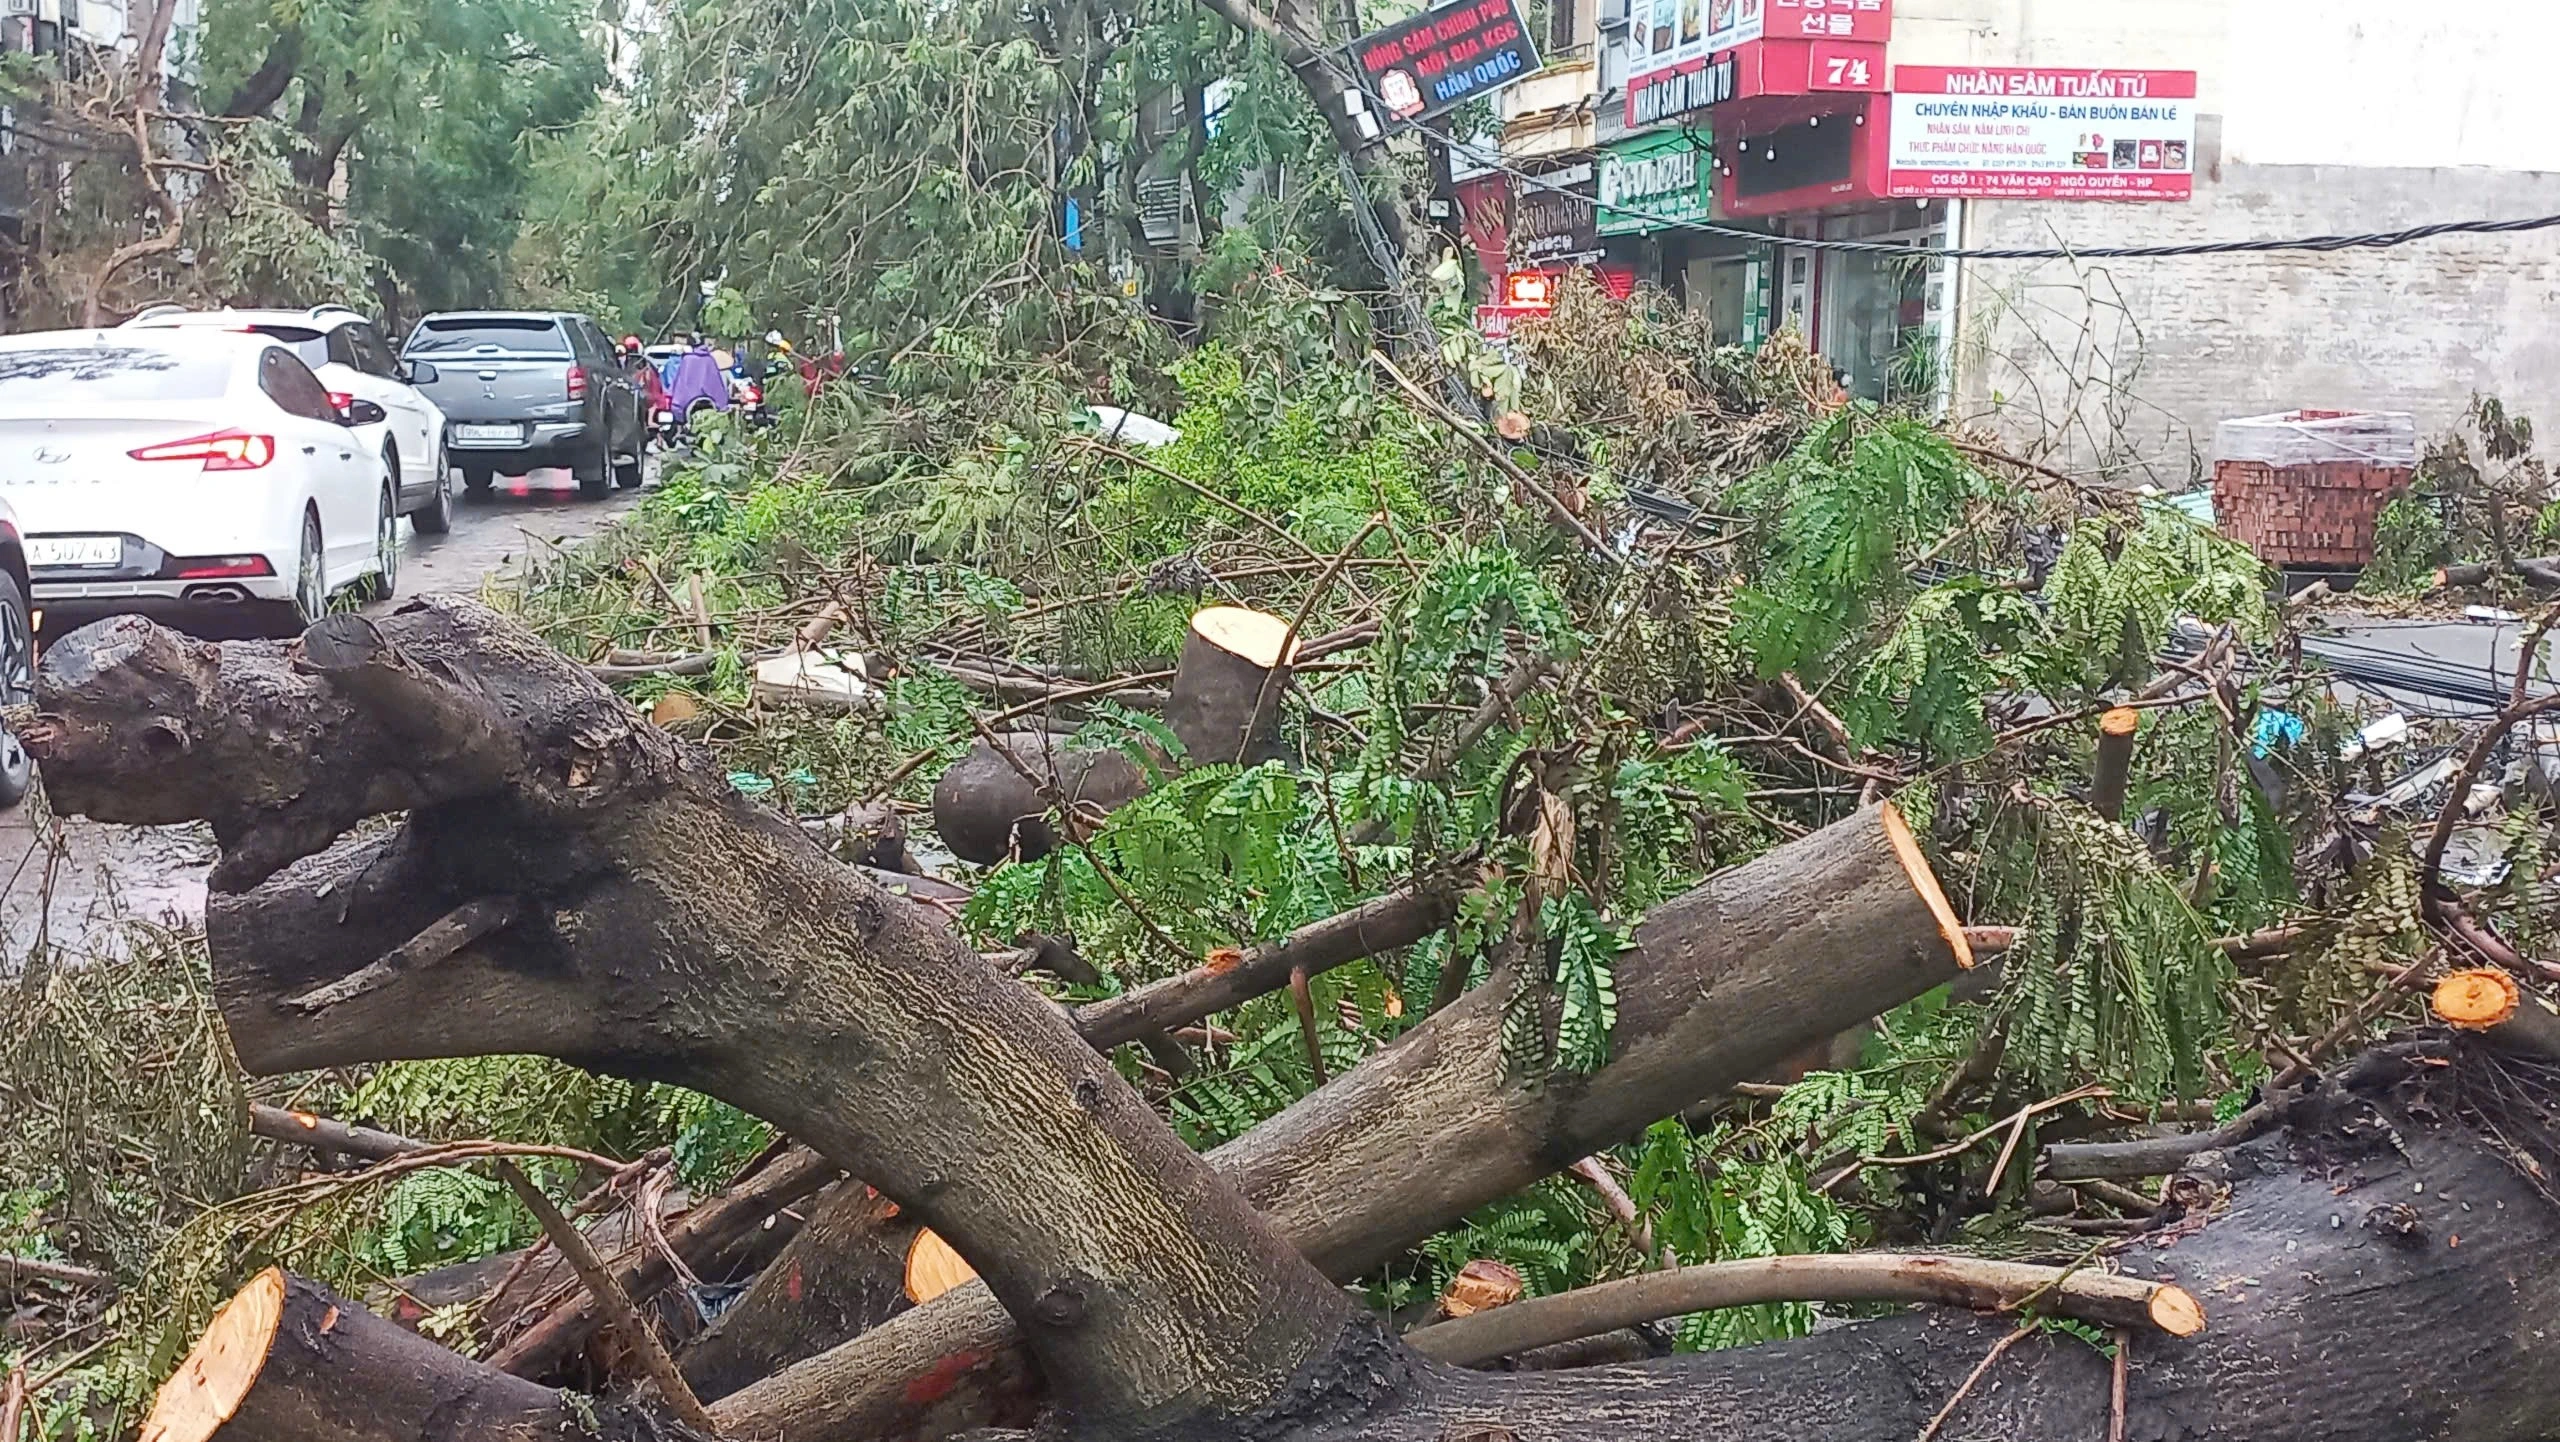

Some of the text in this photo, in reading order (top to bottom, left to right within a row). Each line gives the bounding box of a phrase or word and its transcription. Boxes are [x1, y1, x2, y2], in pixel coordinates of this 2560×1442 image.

[1482, 21, 1519, 47] KGC
[1435, 48, 1522, 101] HÀN QUỐC
[1826, 58, 1871, 85] 74
[1946, 69, 2147, 97] NHÂN SÂM TUẤN TÚ
[1916, 101, 1968, 116] CHUYÊN
[1972, 101, 2008, 120] NHẬP
[2012, 101, 2047, 118] KHẨU
[2059, 104, 2086, 119] BÁN
[2090, 104, 2127, 119] BUÔN
[2131, 104, 2158, 120] BÁN
[1931, 173, 1950, 185] CƠ
[1951, 171, 1968, 185] SỞ
[1970, 174, 1976, 185] 1
[1986, 175, 1999, 186] 74
[2001, 172, 2025, 186] VĂN
[2027, 175, 2051, 187] CAO
[2060, 174, 2086, 187] NGÔ
[2088, 172, 2128, 188] QUYỀN
[2137, 177, 2153, 188] HP
